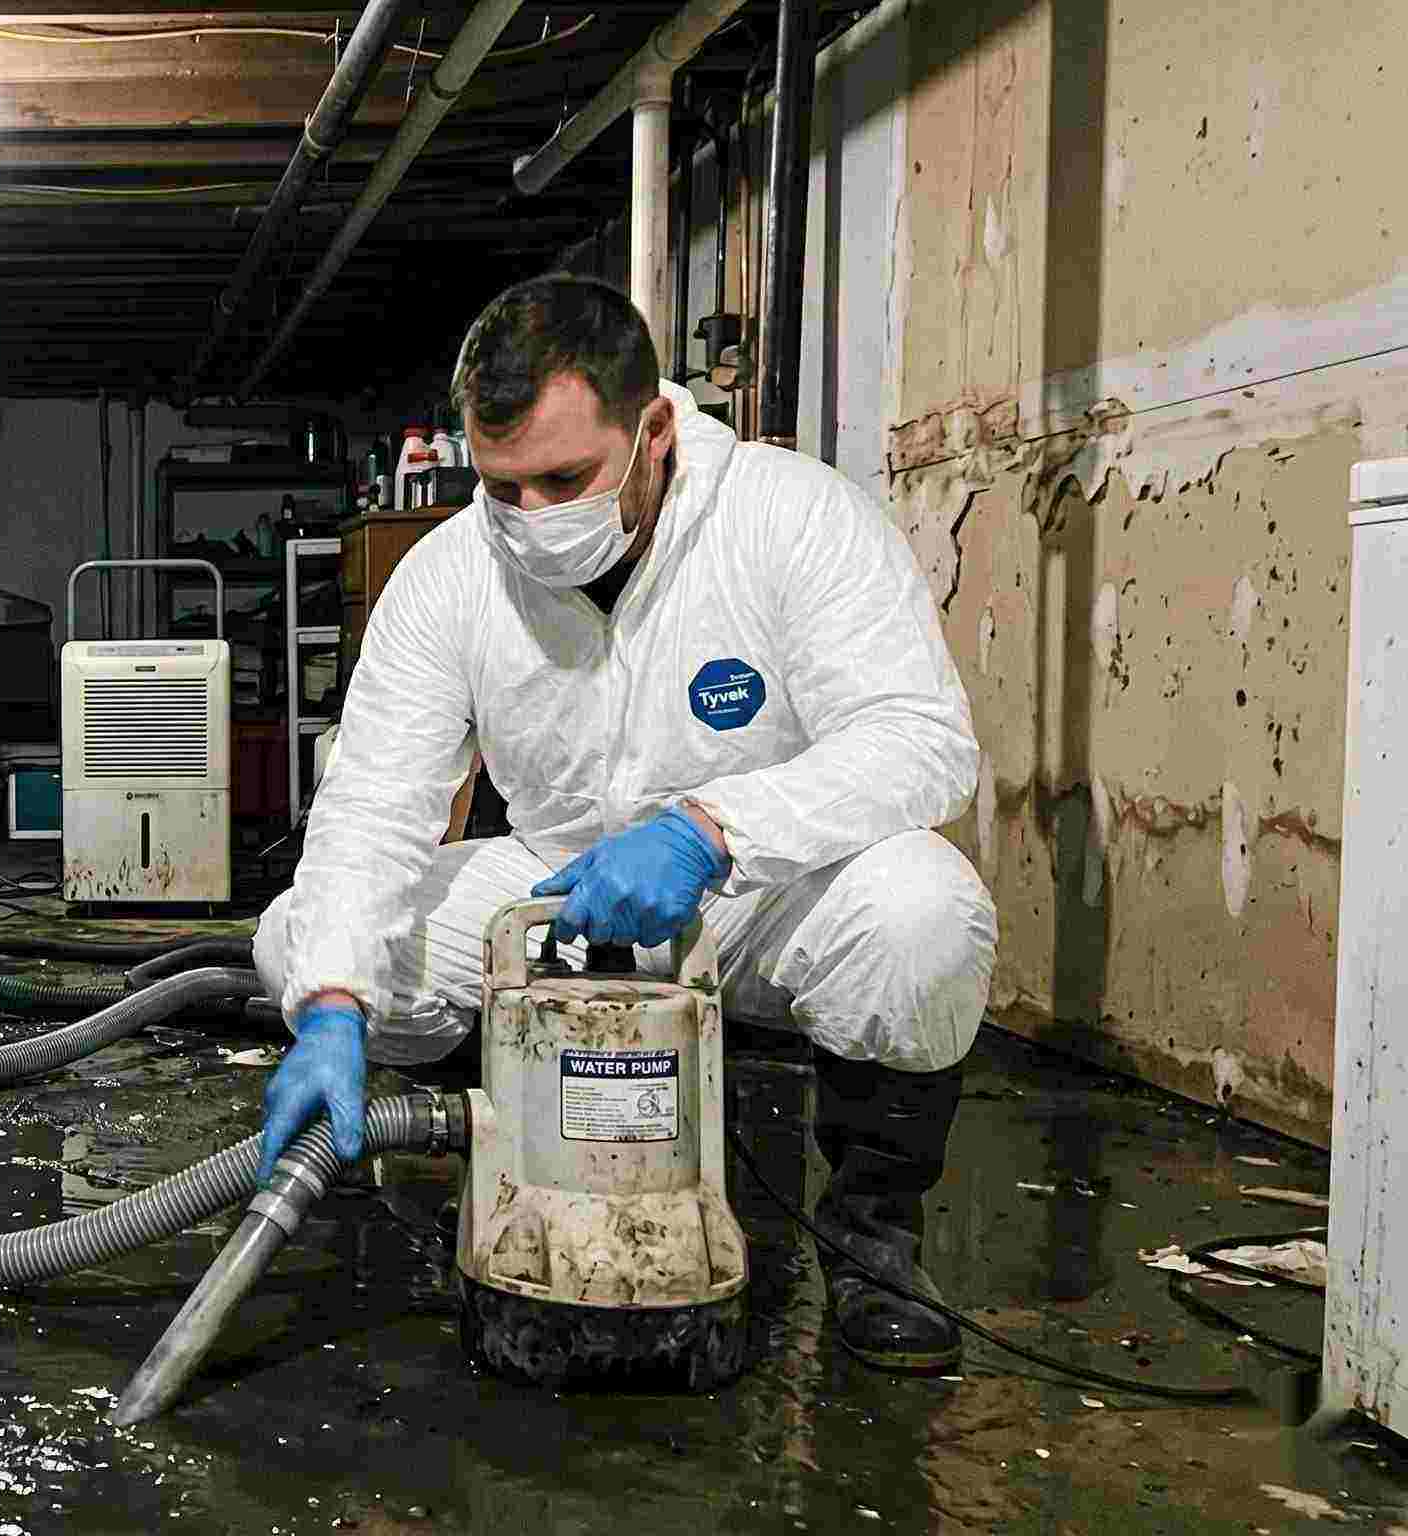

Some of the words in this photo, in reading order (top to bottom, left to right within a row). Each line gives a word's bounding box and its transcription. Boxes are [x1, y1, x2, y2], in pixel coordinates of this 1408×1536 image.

[698, 686, 749, 708] Tyvek
[571, 1060, 626, 1075] WATER
[631, 1061, 672, 1075] PUMP
